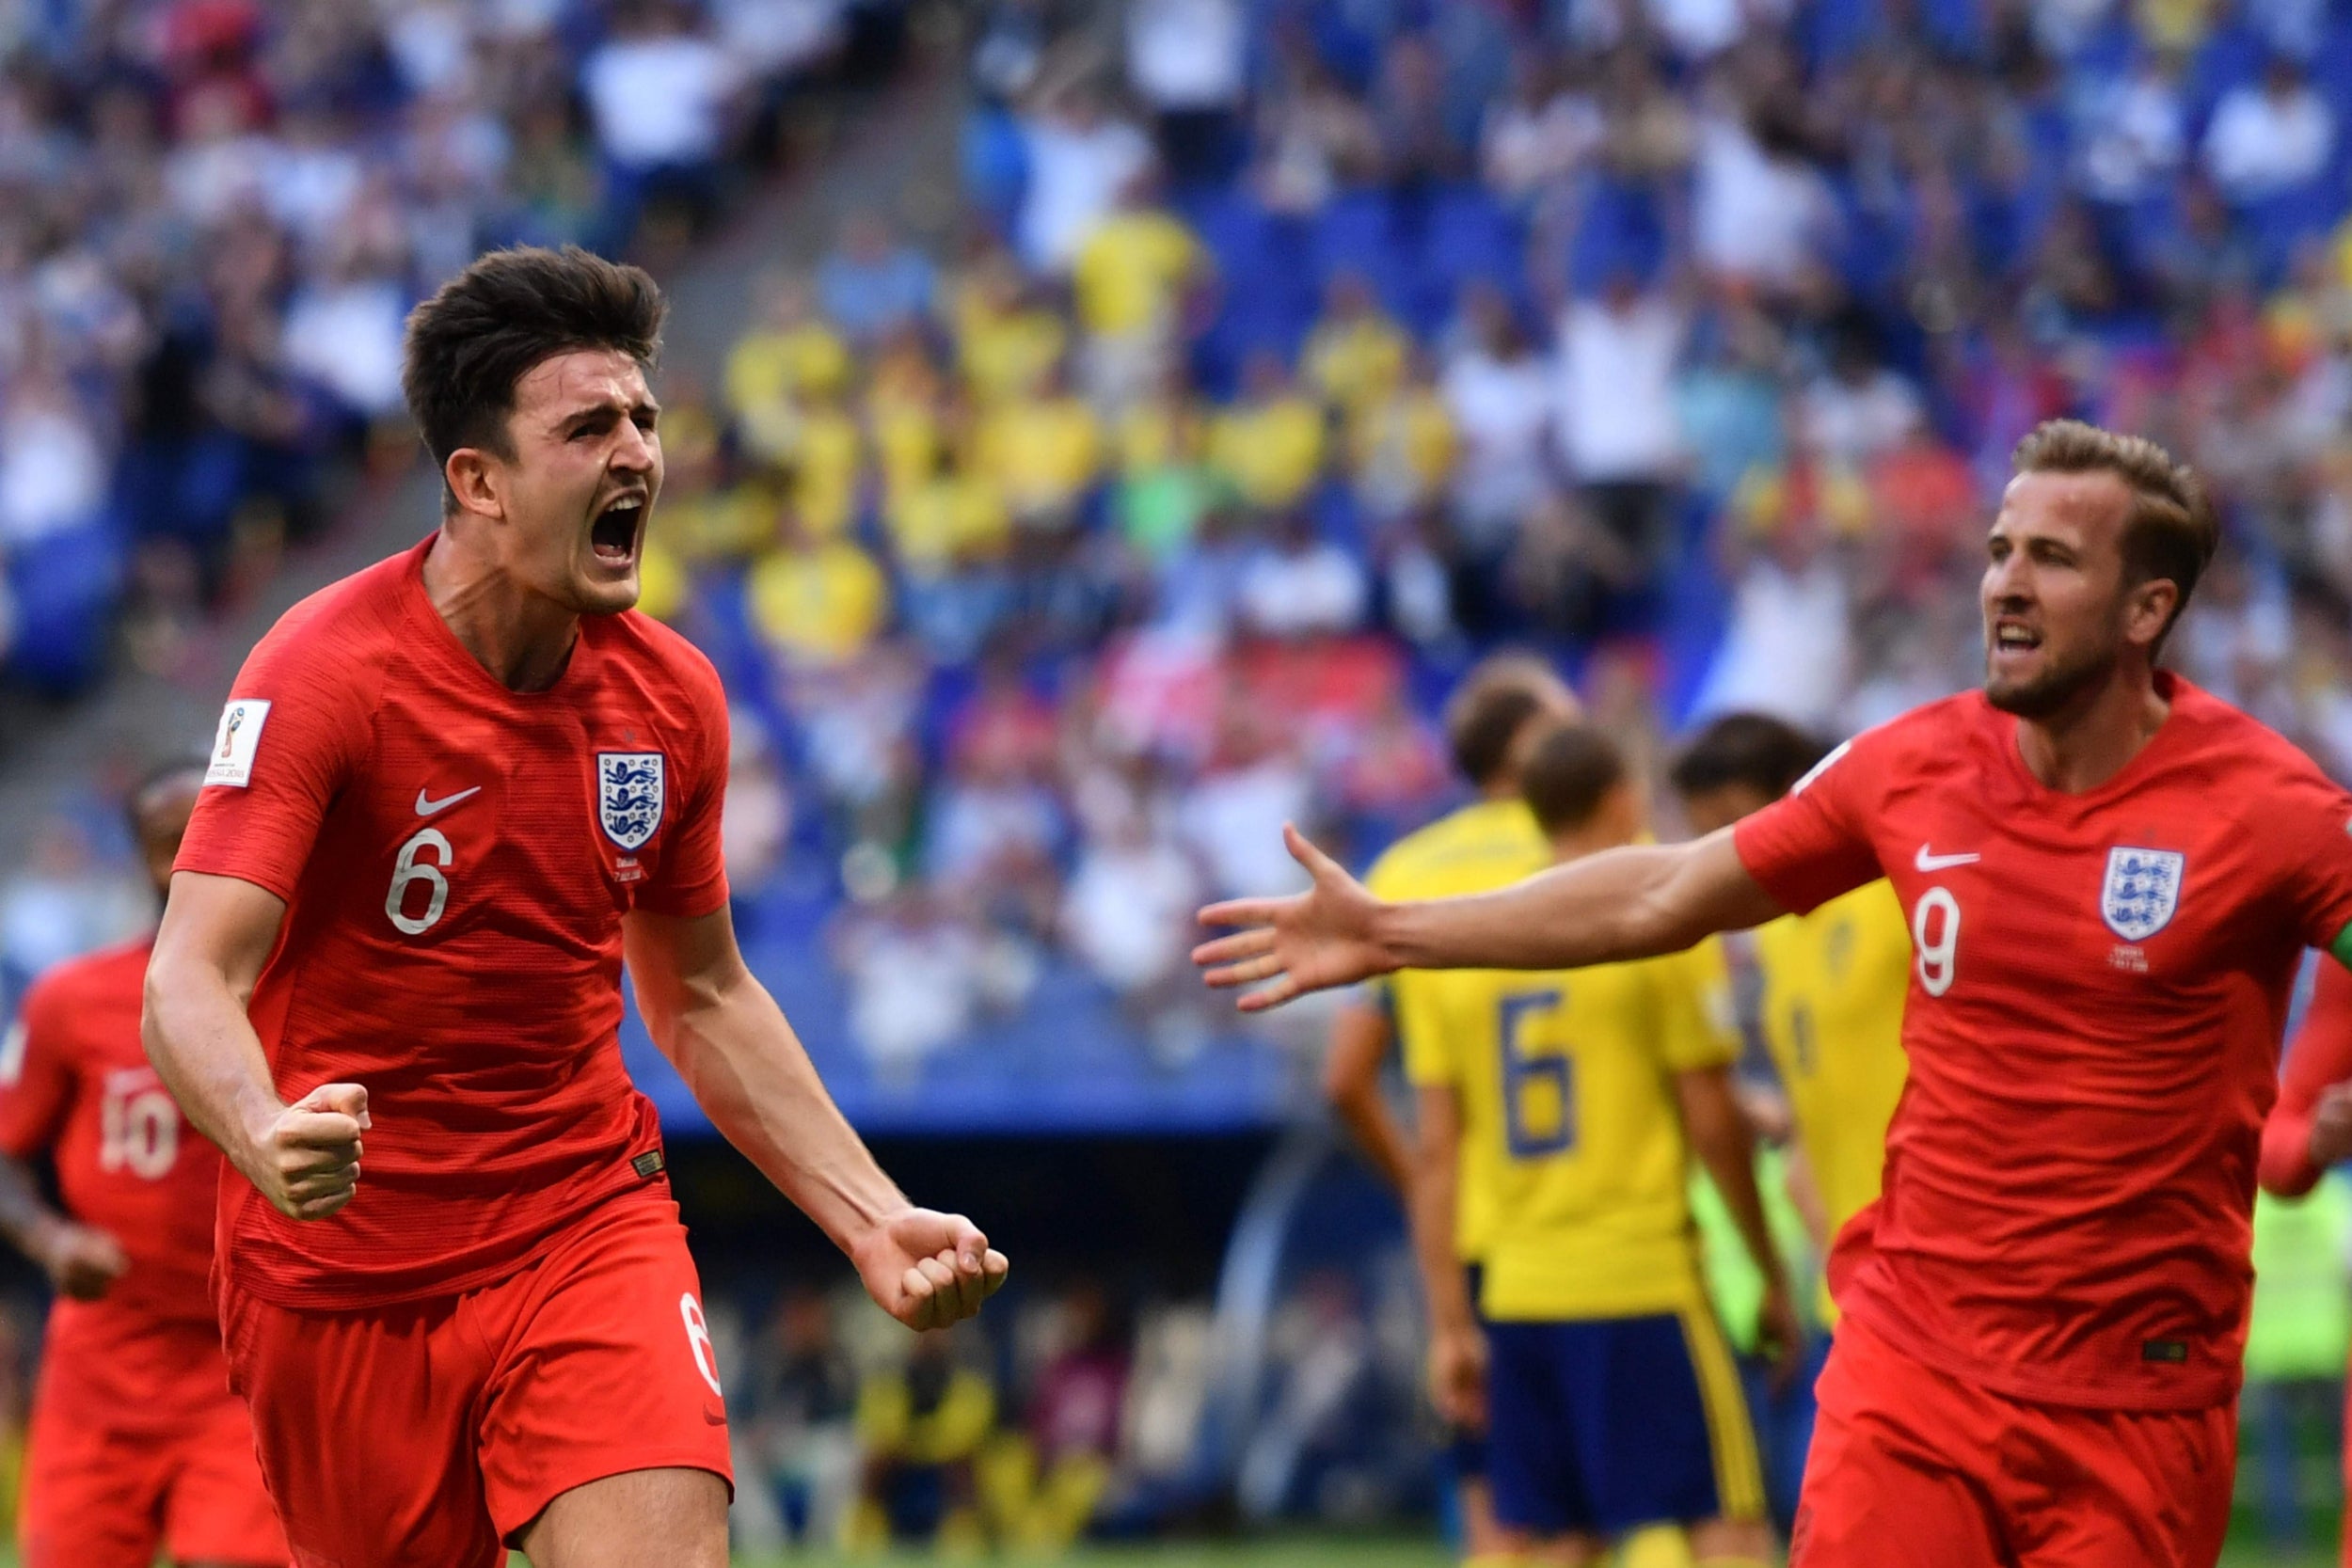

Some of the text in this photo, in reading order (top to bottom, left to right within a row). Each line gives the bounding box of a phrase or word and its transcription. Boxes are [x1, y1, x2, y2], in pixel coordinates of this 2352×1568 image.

[385, 829, 452, 934] 6
[1915, 886, 1961, 997] 9
[1498, 991, 1573, 1156] 6
[100, 1091, 177, 1180] 10
[680, 1292, 722, 1397] 6
